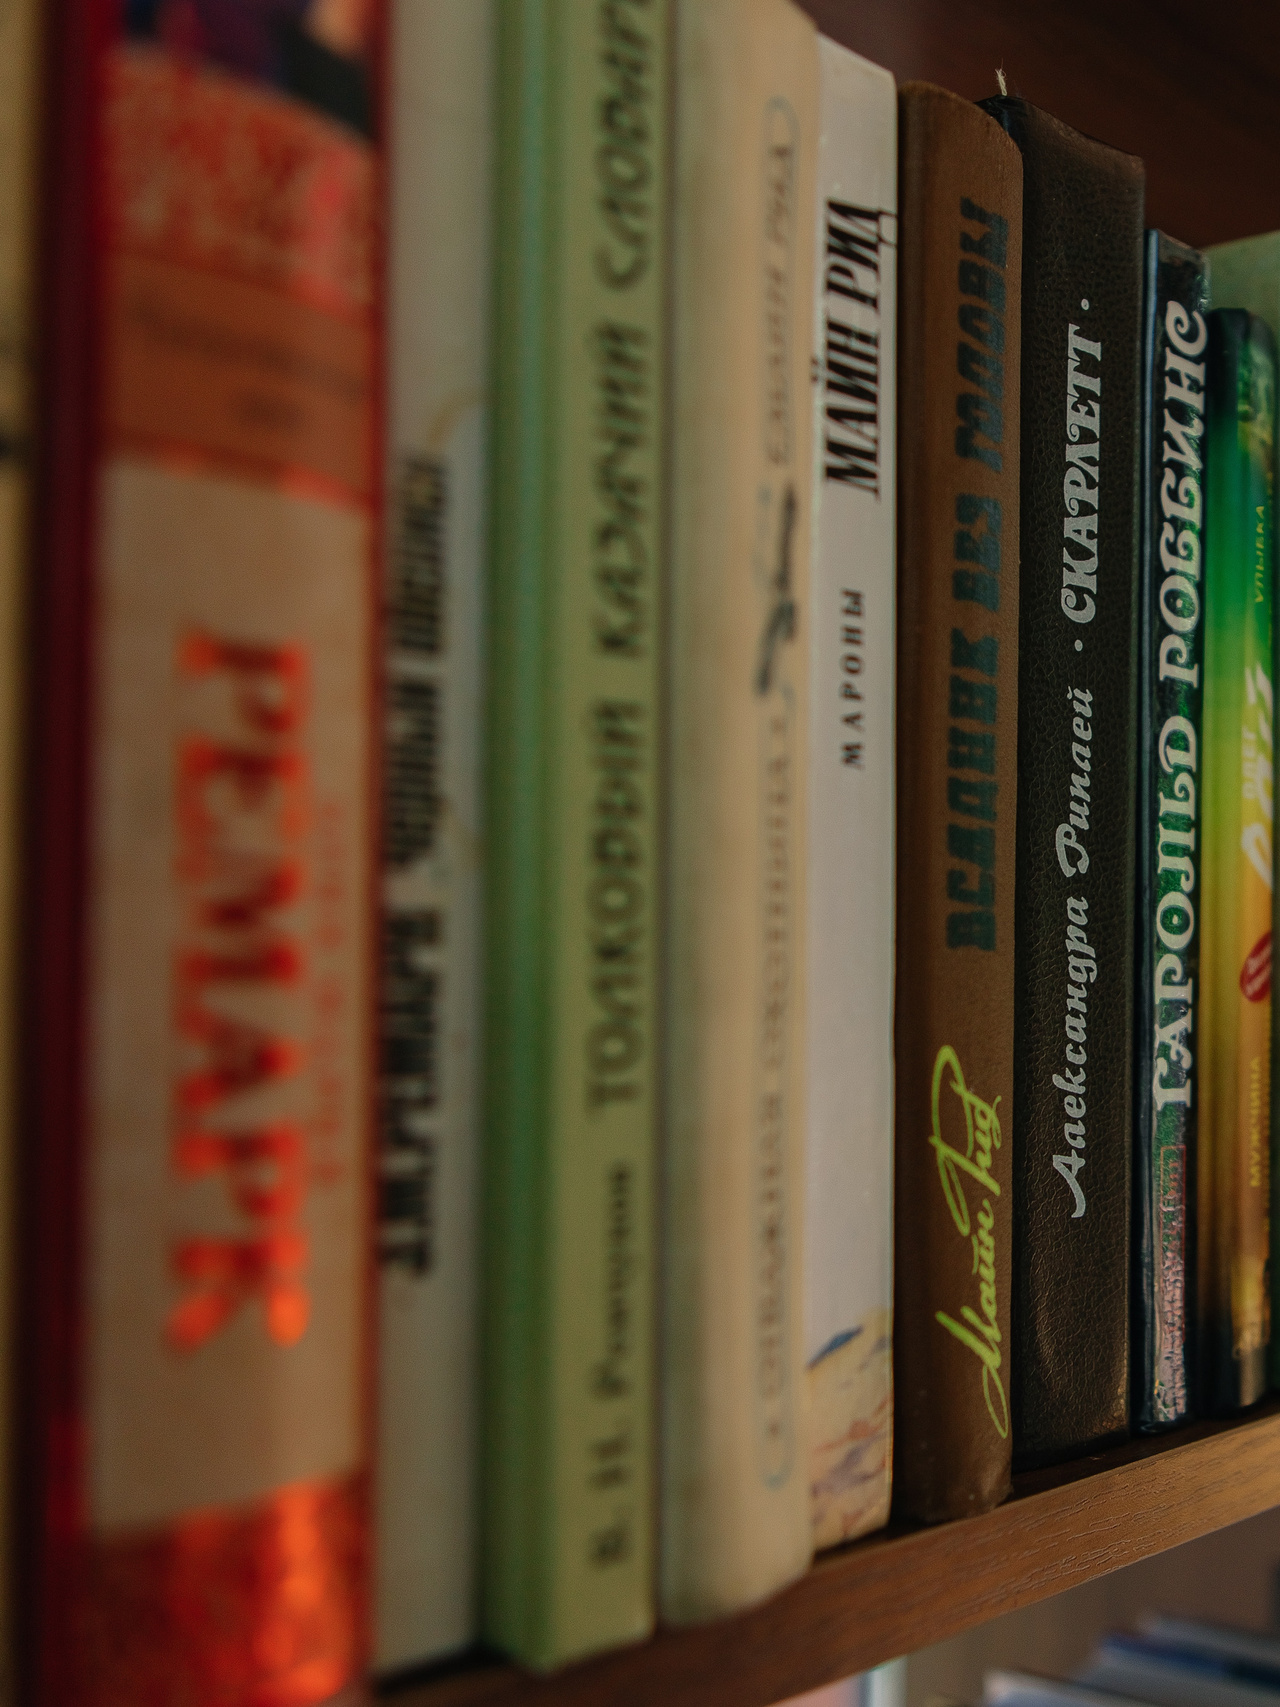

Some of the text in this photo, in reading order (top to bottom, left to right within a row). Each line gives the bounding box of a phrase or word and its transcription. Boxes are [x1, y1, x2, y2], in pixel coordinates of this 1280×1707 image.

[590, 323, 648, 660] КАЗАЧИЙ
[821, 197, 895, 497] МАЙН РИД
[1061, 325, 1102, 623] СКАРЛЕТТ
[1157, 307, 1208, 685] РОББИНС
[839, 588, 866, 771] МАРОНЫ
[947, 197, 1006, 949] ВСАДНИК БЕЗ ГОЛОВЫ
[1254, 505, 1265, 603] УЛЫБКА
[168, 630, 310, 1352] РЕМАРК
[585, 700, 648, 1119] ТОЛКОВЫЙ
[1055, 689, 1099, 1219] Александра Риплей
[1153, 715, 1202, 1110] ГАРОЛЬД
[1248, 1057, 1262, 1188] МУЖЧИНА
